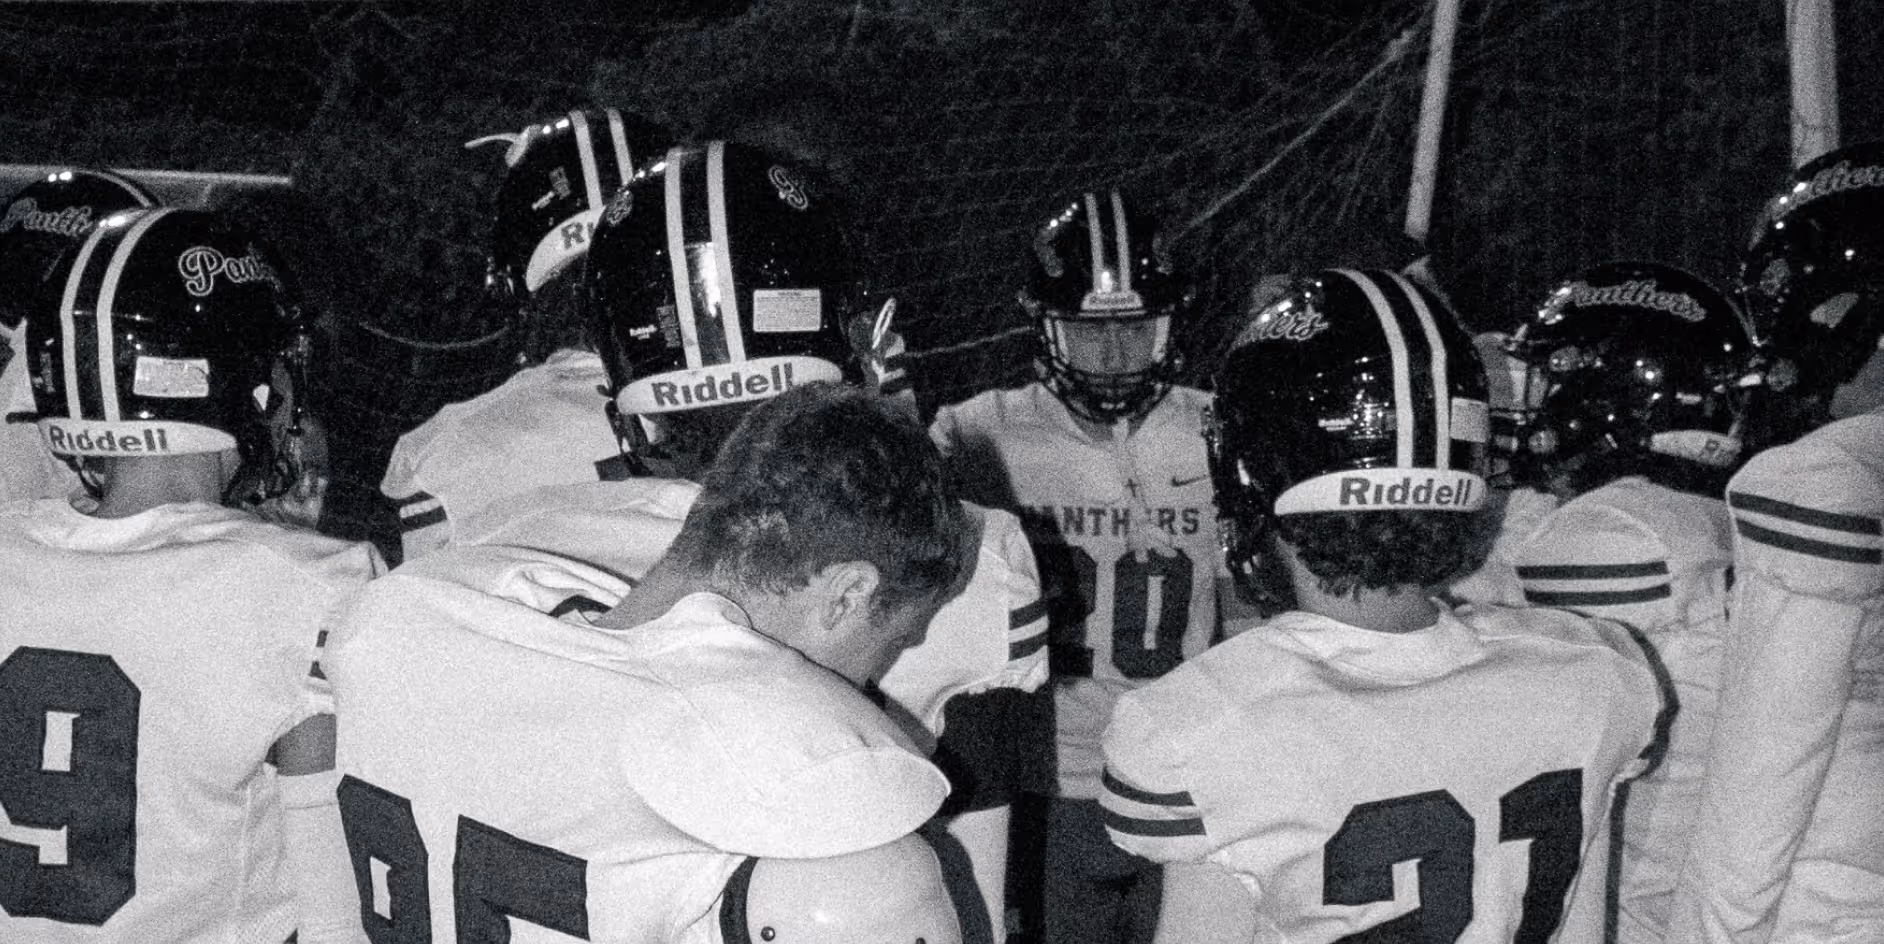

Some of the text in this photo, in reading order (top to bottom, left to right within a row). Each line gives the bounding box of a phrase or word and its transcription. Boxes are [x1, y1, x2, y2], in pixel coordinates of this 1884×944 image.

[651, 362, 794, 407] Riddell
[50, 424, 169, 453] Riddell
[1340, 477, 1473, 506] Riddell
